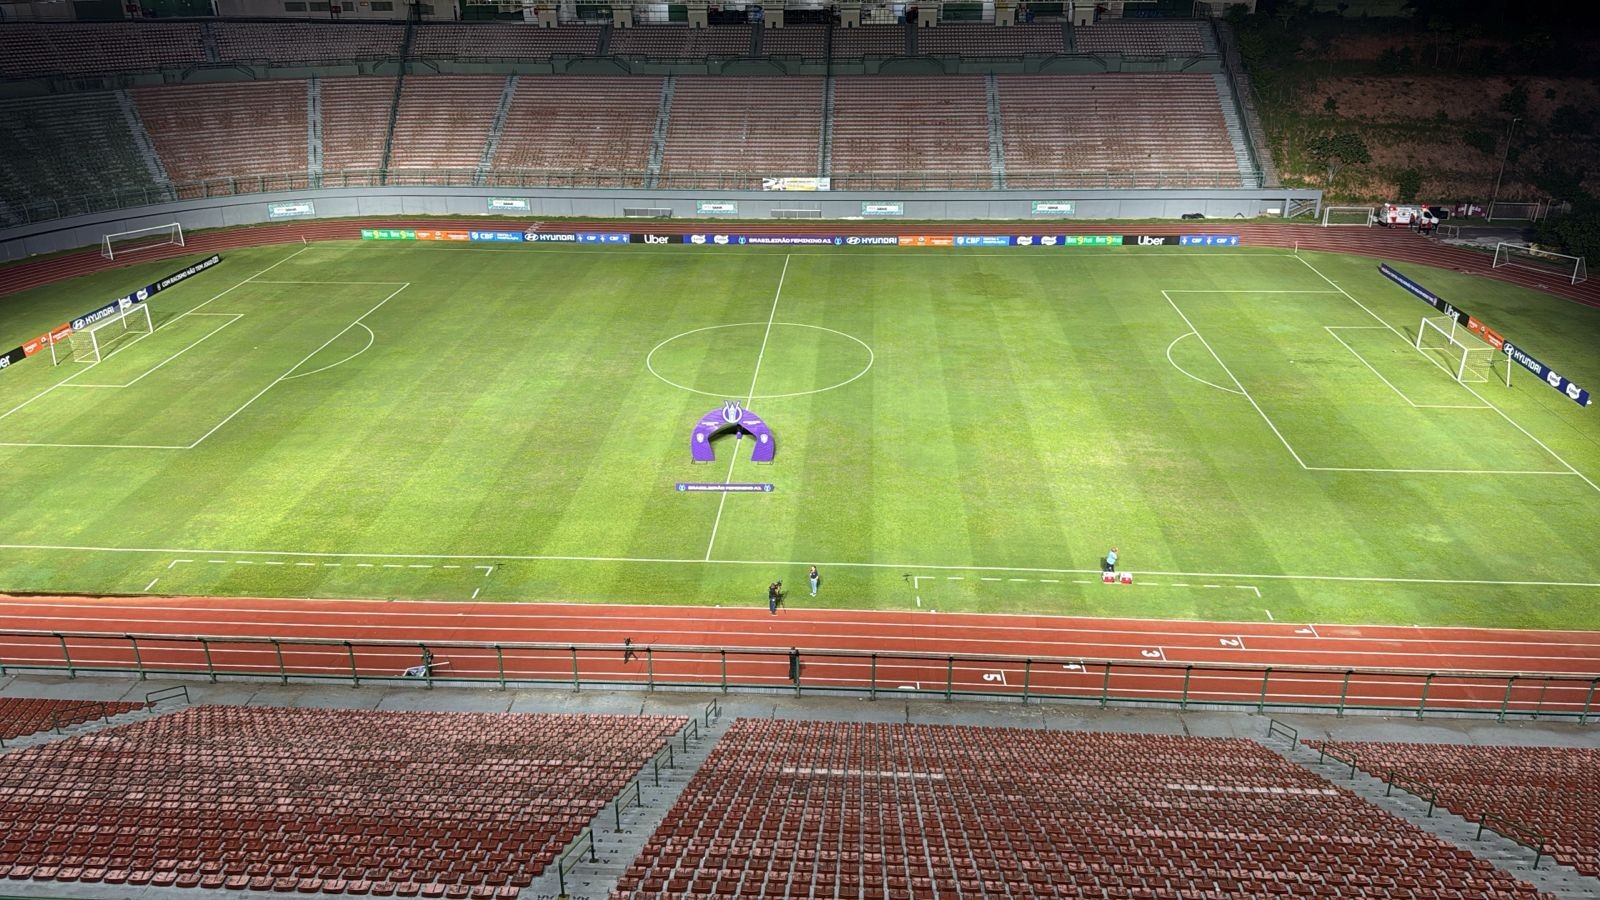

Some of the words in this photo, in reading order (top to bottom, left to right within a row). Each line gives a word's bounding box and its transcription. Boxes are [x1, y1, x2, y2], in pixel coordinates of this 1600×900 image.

[644, 234, 669, 244] Uber
[1138, 236, 1164, 245] Uber
[85, 306, 114, 324] HYUNDAI
[1514, 350, 1542, 374] HYUNDAI
[982, 673, 1002, 682] 5
